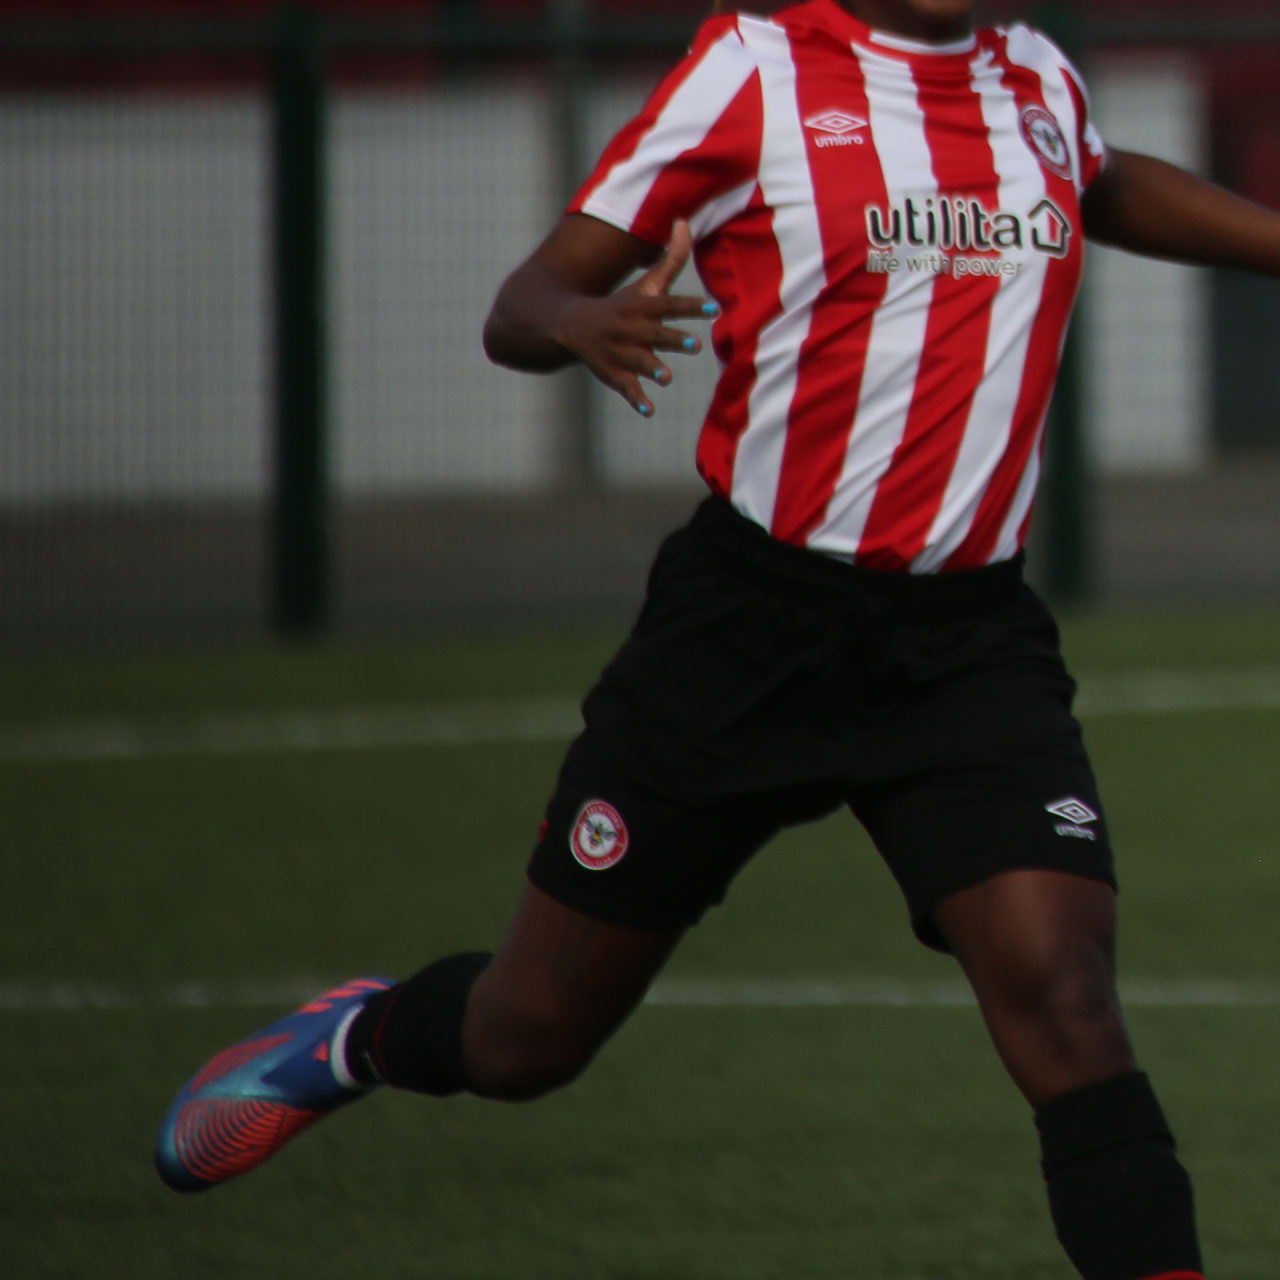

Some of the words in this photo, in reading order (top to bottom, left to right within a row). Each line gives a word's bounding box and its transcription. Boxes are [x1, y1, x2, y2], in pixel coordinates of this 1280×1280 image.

[814, 134, 864, 148] umbro
[868, 197, 1024, 251] utilita
[866, 249, 900, 273] life
[905, 253, 950, 273] with
[952, 255, 1024, 280] power
